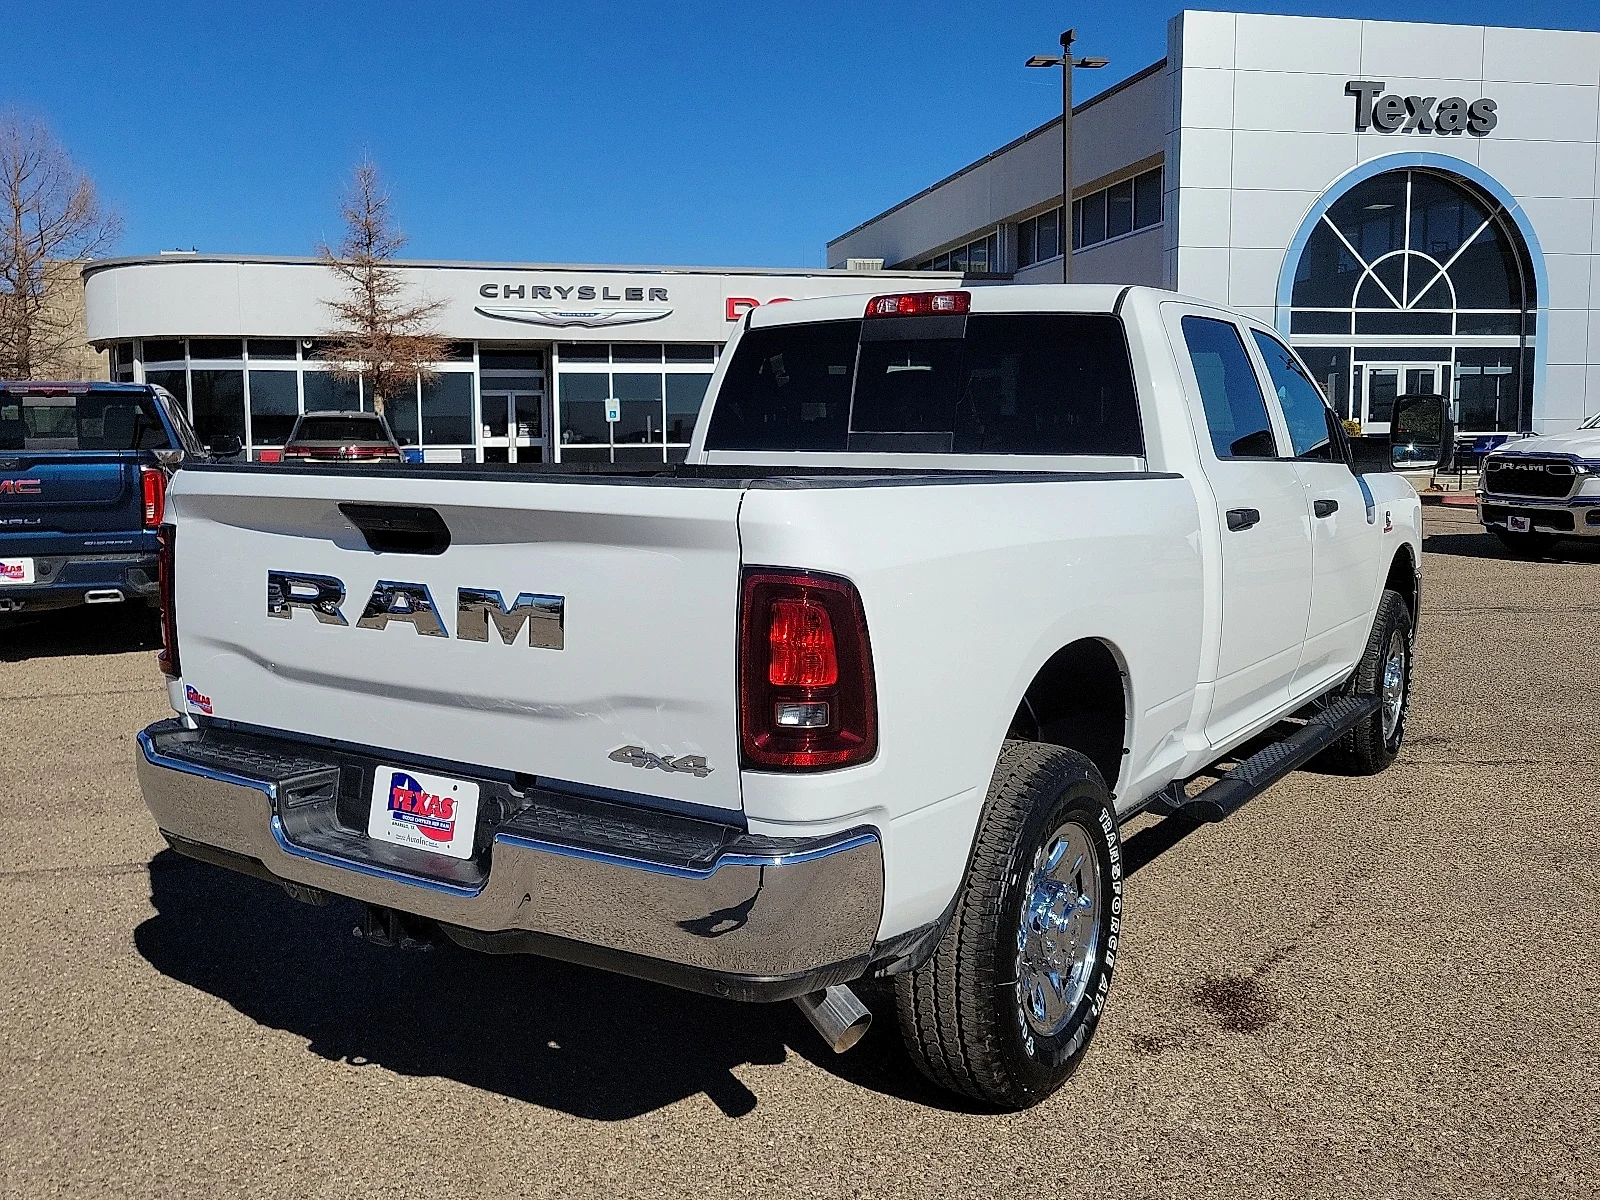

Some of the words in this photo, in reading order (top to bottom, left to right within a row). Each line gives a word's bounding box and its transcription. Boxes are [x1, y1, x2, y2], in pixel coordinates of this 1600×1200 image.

[1344, 81, 1498, 137] Texas
[480, 284, 669, 301] CHRYSLER
[1499, 462, 1544, 472] RAM
[268, 570, 565, 651] RAM
[392, 787, 454, 820] TEXAS
[1098, 807, 1122, 968] TRANSFORCE
